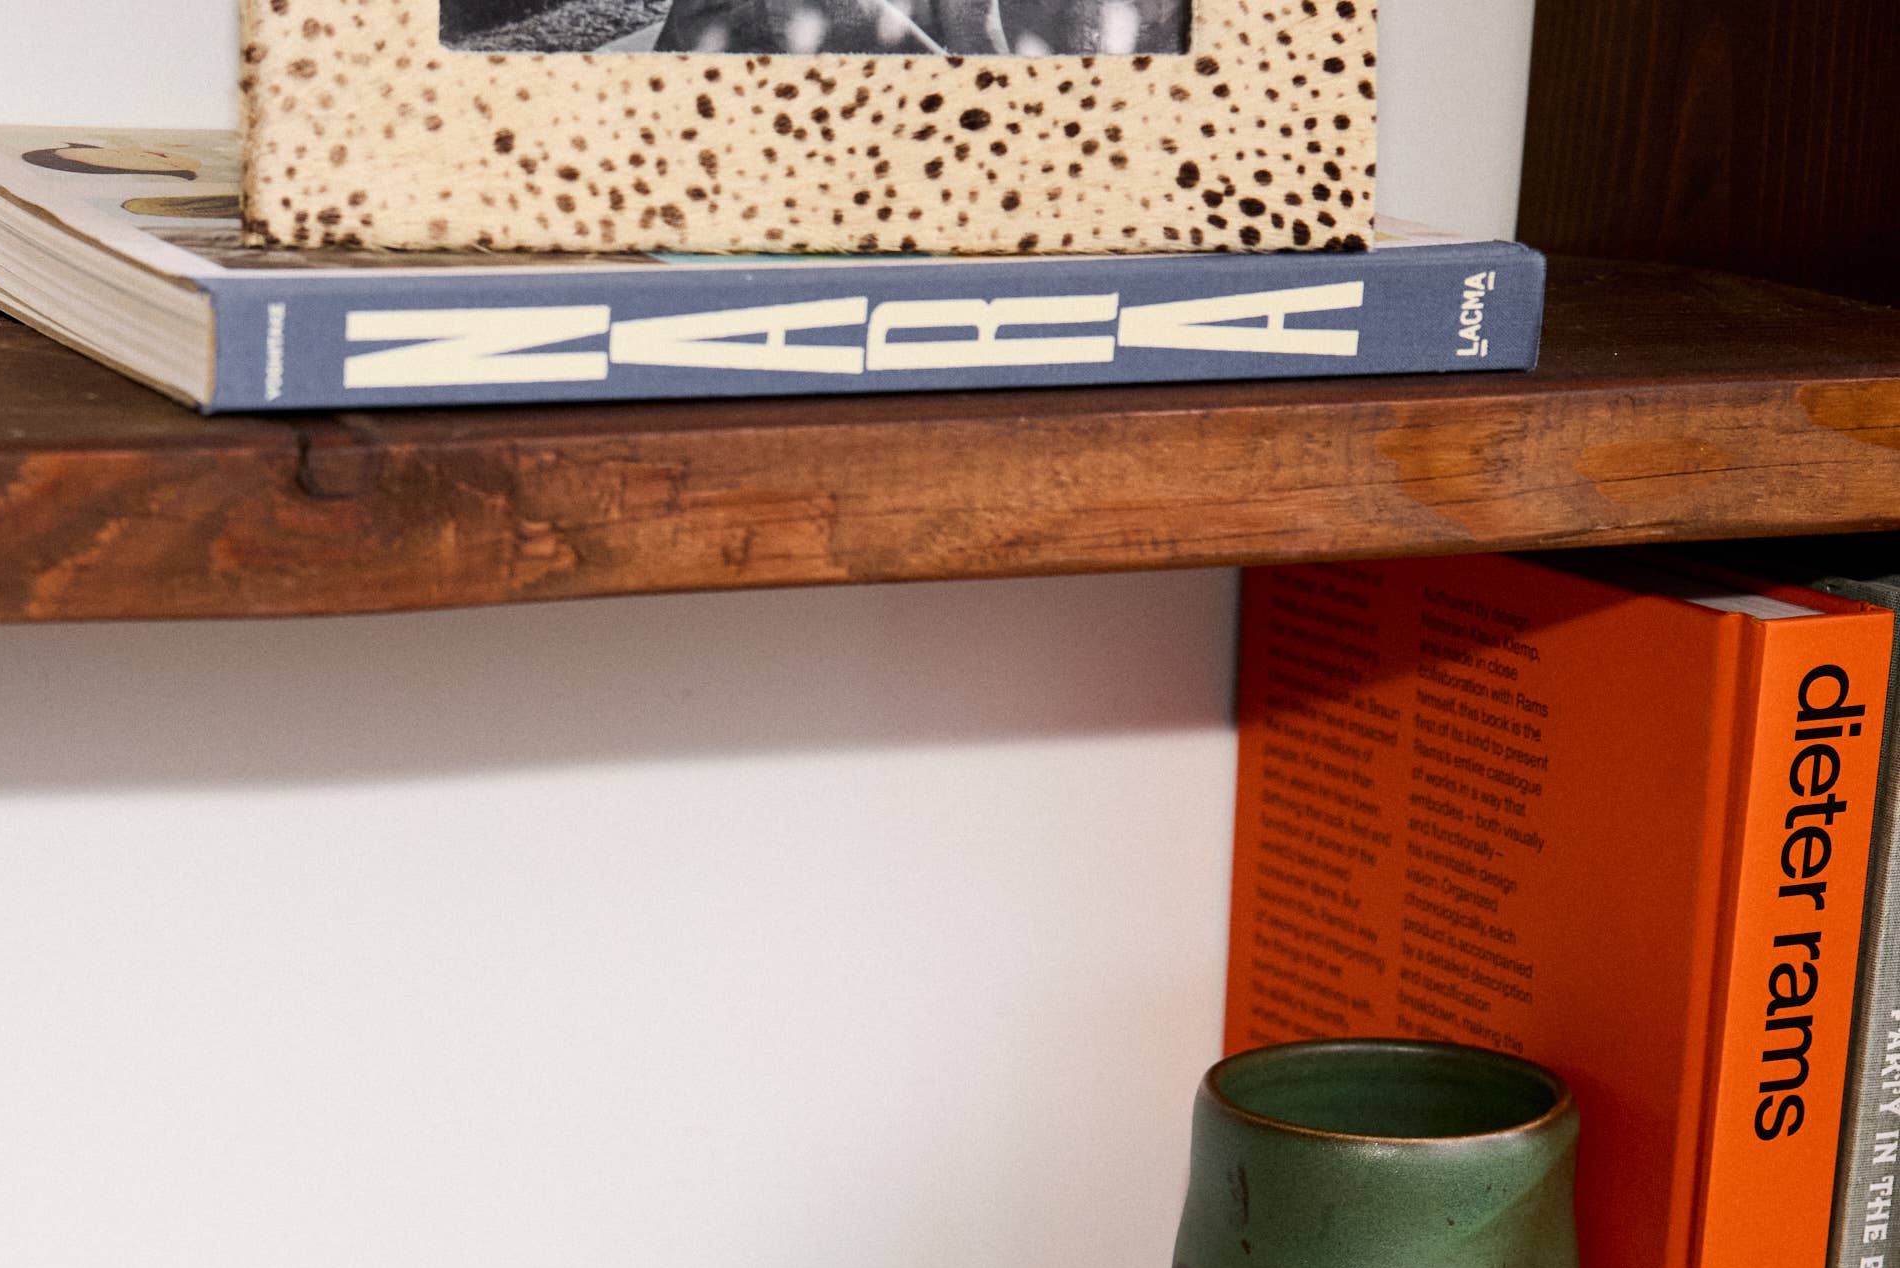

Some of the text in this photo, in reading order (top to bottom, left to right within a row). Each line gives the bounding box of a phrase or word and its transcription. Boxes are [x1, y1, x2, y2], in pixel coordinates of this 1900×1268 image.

[344, 281, 1364, 389] NARA
[1456, 270, 1493, 357] LACMA
[1516, 694, 1548, 715] Rams
[1753, 664, 1865, 1142] dieter rams
[1873, 1130, 1899, 1165] IN
[1862, 1175, 1895, 1244] THE
